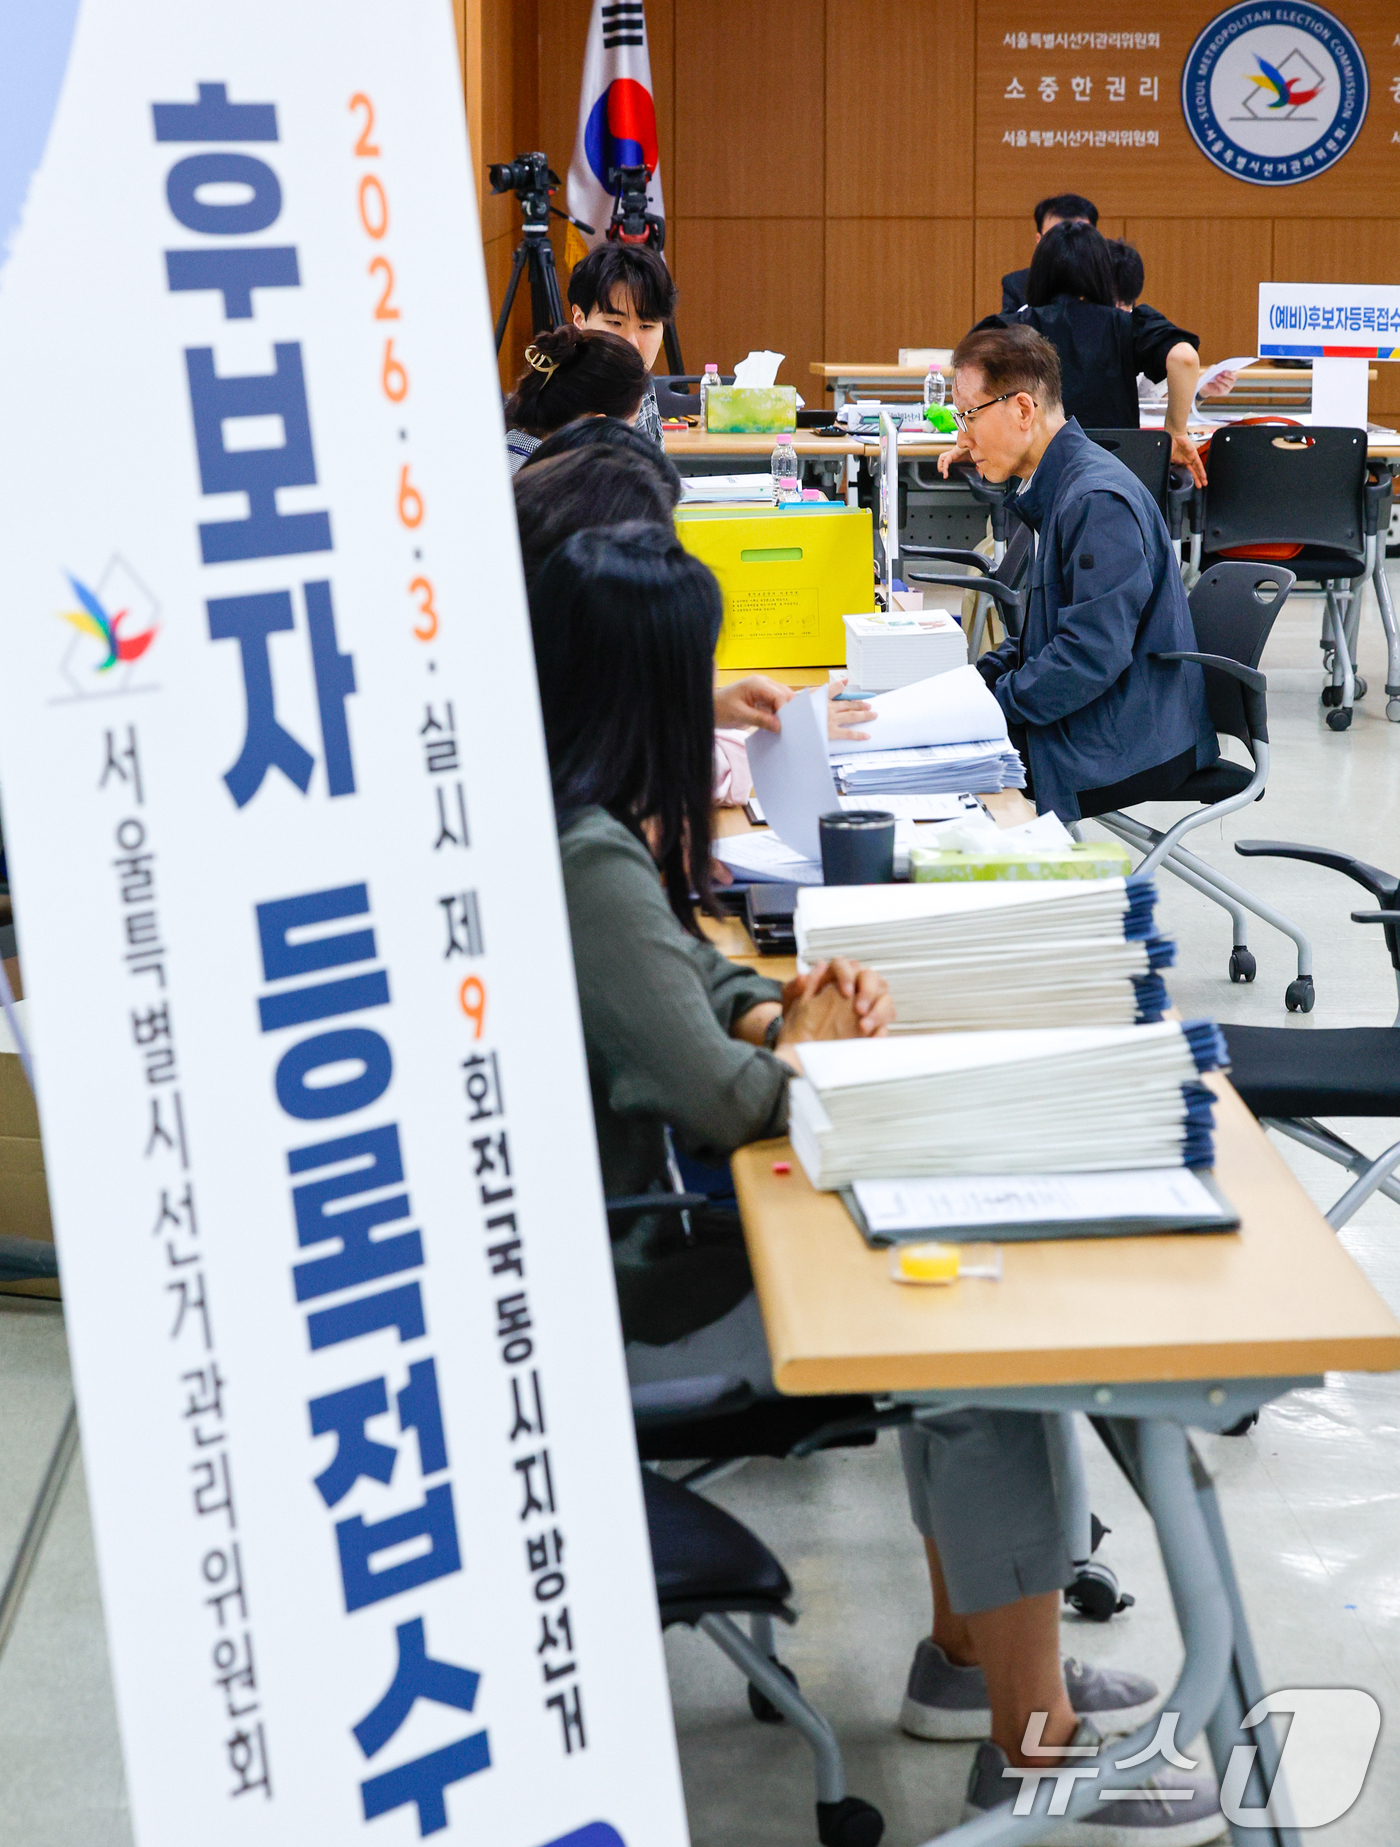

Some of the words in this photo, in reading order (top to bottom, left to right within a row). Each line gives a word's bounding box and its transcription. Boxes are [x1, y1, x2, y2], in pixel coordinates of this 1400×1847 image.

[1003, 32, 1160, 49] 서울특별시선거관리위원회
[1198, 10, 1271, 76] METROPOLITAN
[1275, 9, 1331, 40] ELECTION
[1195, 80, 1209, 121] SEOUL
[1330, 39, 1356, 119] COMMISSION
[1002, 130, 1160, 147] 서울특별시선거관리위원회
[1205, 127, 1347, 178] 서울특별시선거관리위원회
[149, 80, 359, 811] 후보자
[98, 722, 274, 1801] 서울특별시선거관리위원회
[253, 879, 491, 1841] 등록접수
